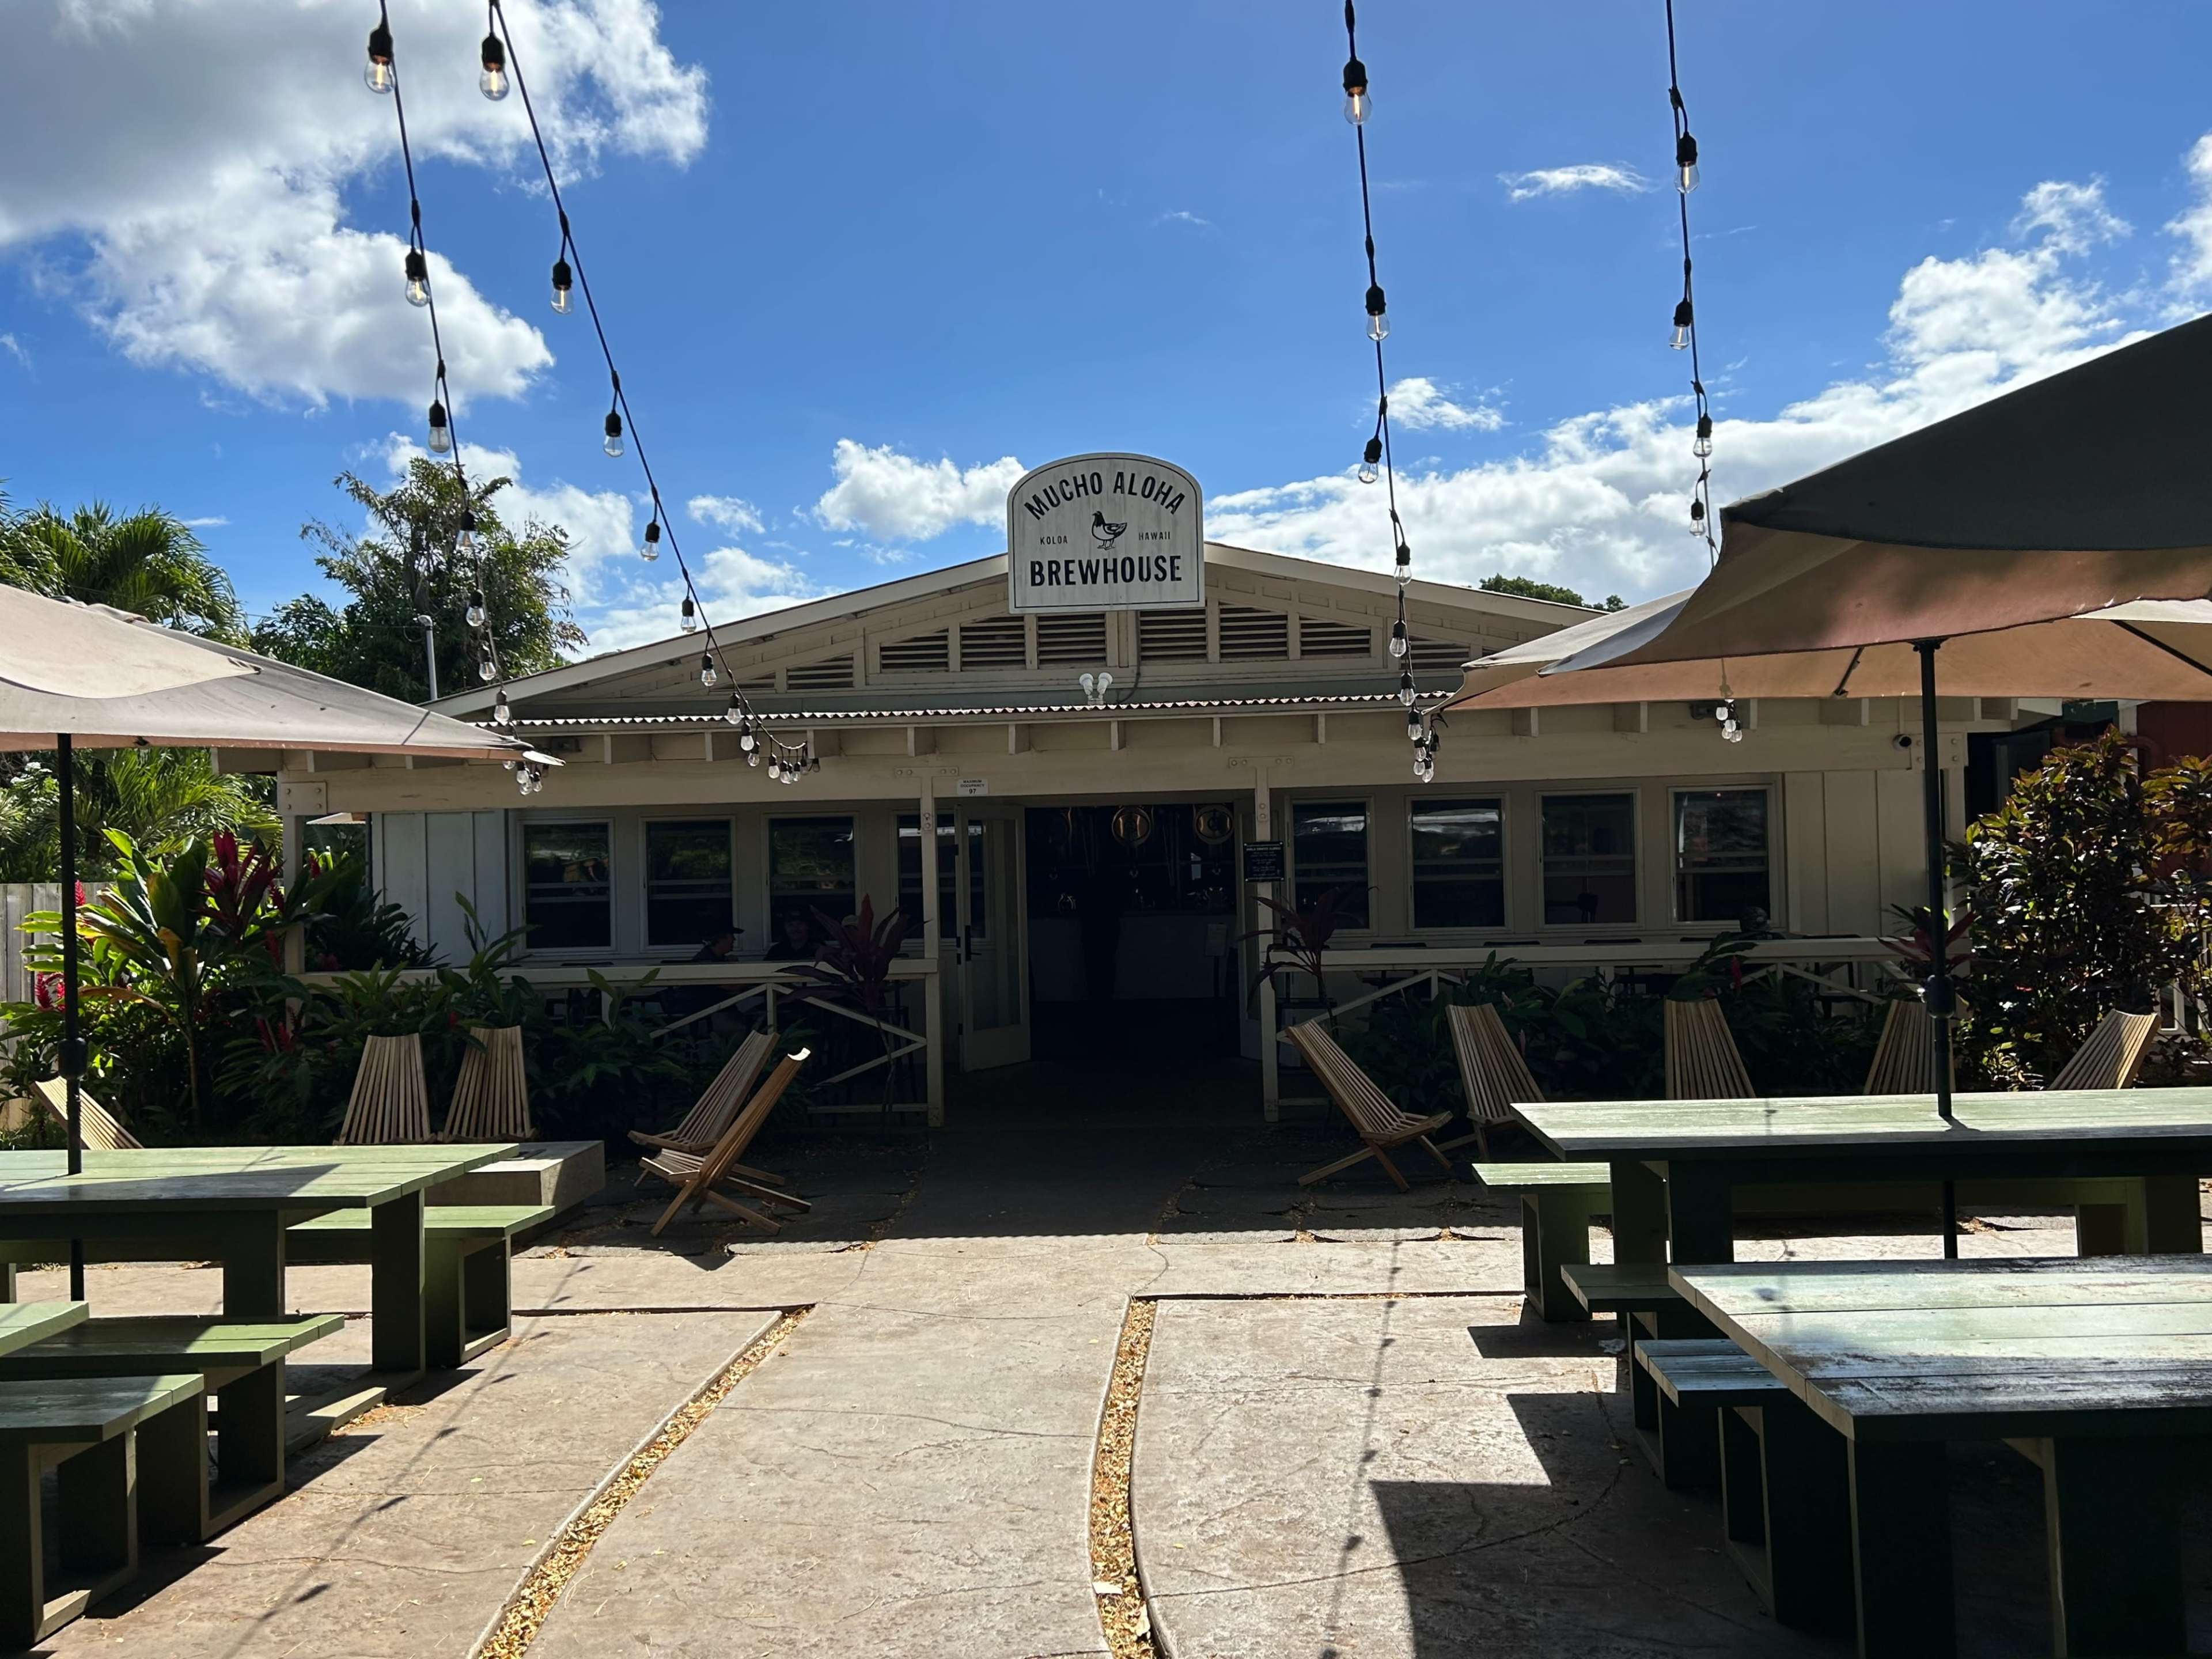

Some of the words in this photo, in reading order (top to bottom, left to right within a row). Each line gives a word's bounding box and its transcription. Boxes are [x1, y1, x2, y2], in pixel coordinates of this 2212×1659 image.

[1024, 471, 1103, 520] MUCHO
[1113, 471, 1185, 515] ALOHA
[1040, 535, 1068, 545] KOLOA
[1138, 531, 1171, 541] HAWAII
[1030, 555, 1182, 587] BREWHOUSE
